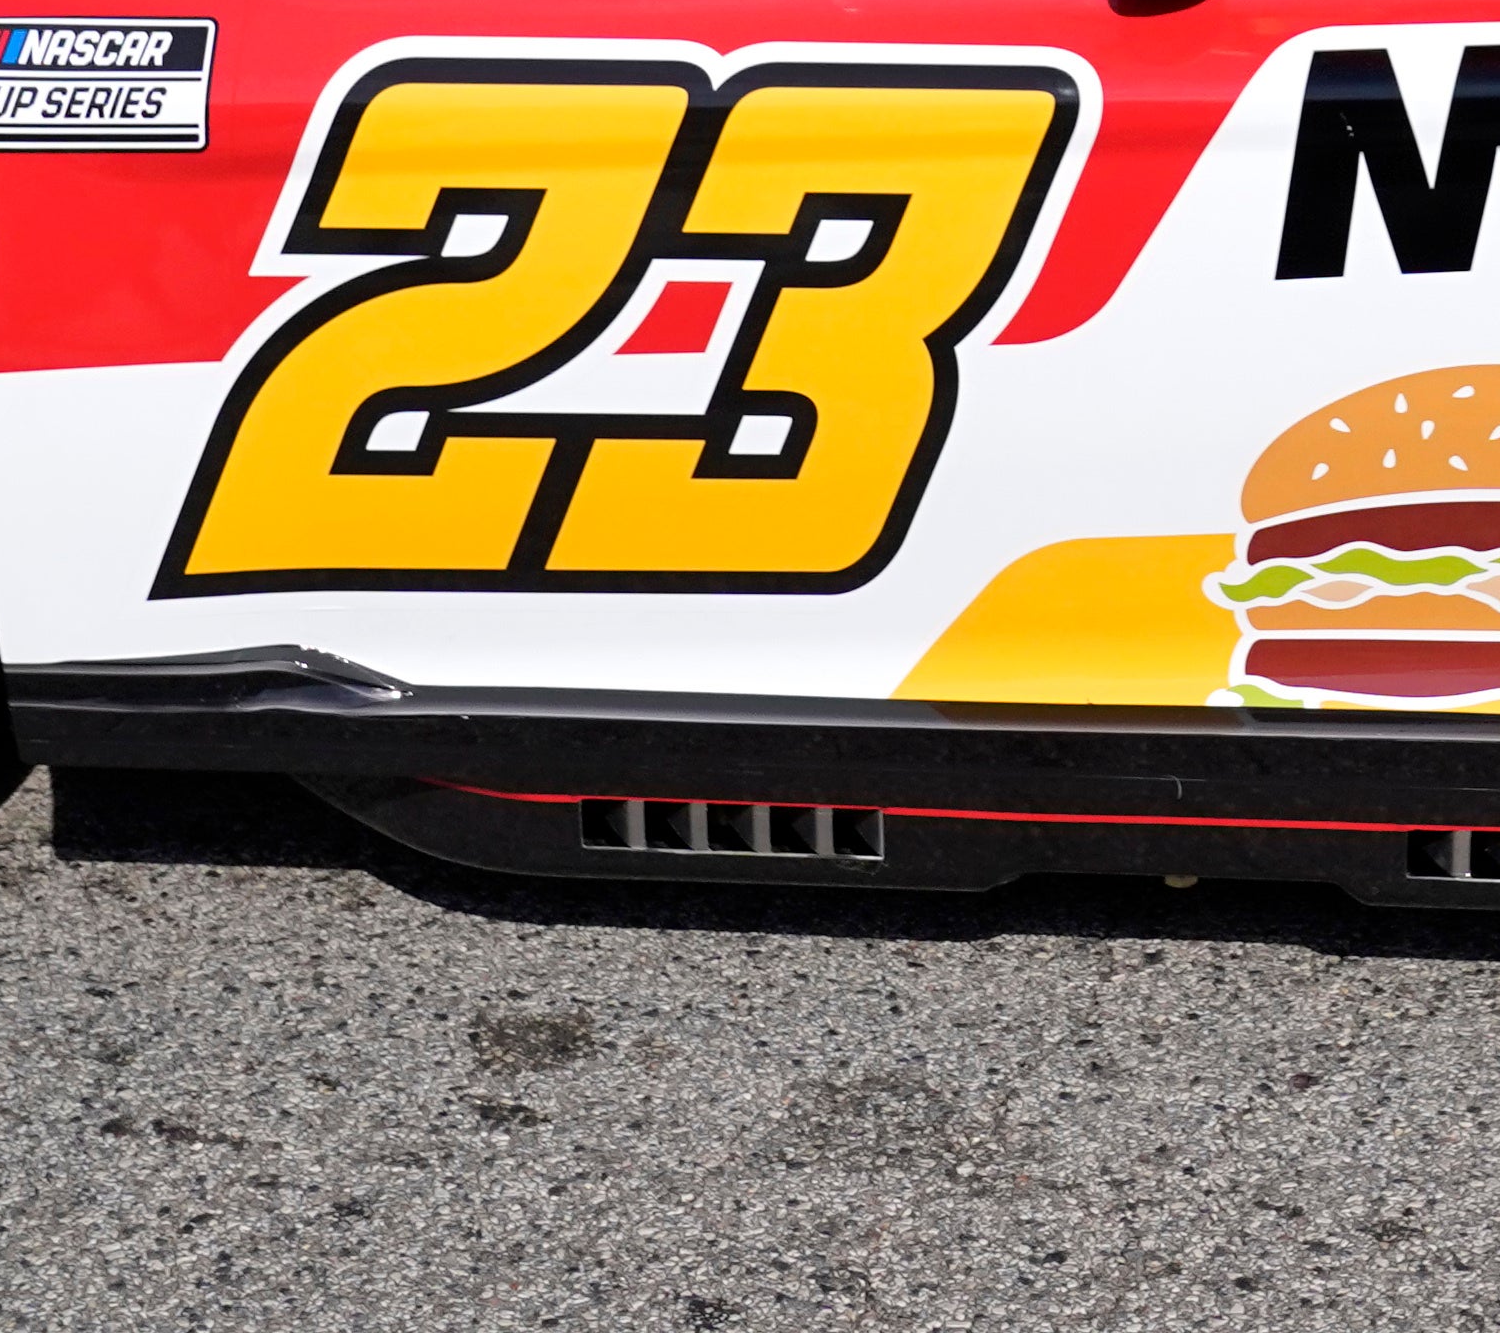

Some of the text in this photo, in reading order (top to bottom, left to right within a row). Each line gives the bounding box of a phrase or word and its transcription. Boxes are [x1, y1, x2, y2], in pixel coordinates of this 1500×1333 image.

[17, 28, 173, 66] NASCAR
[41, 86, 167, 119] SERIES
[147, 57, 1083, 602] 23
